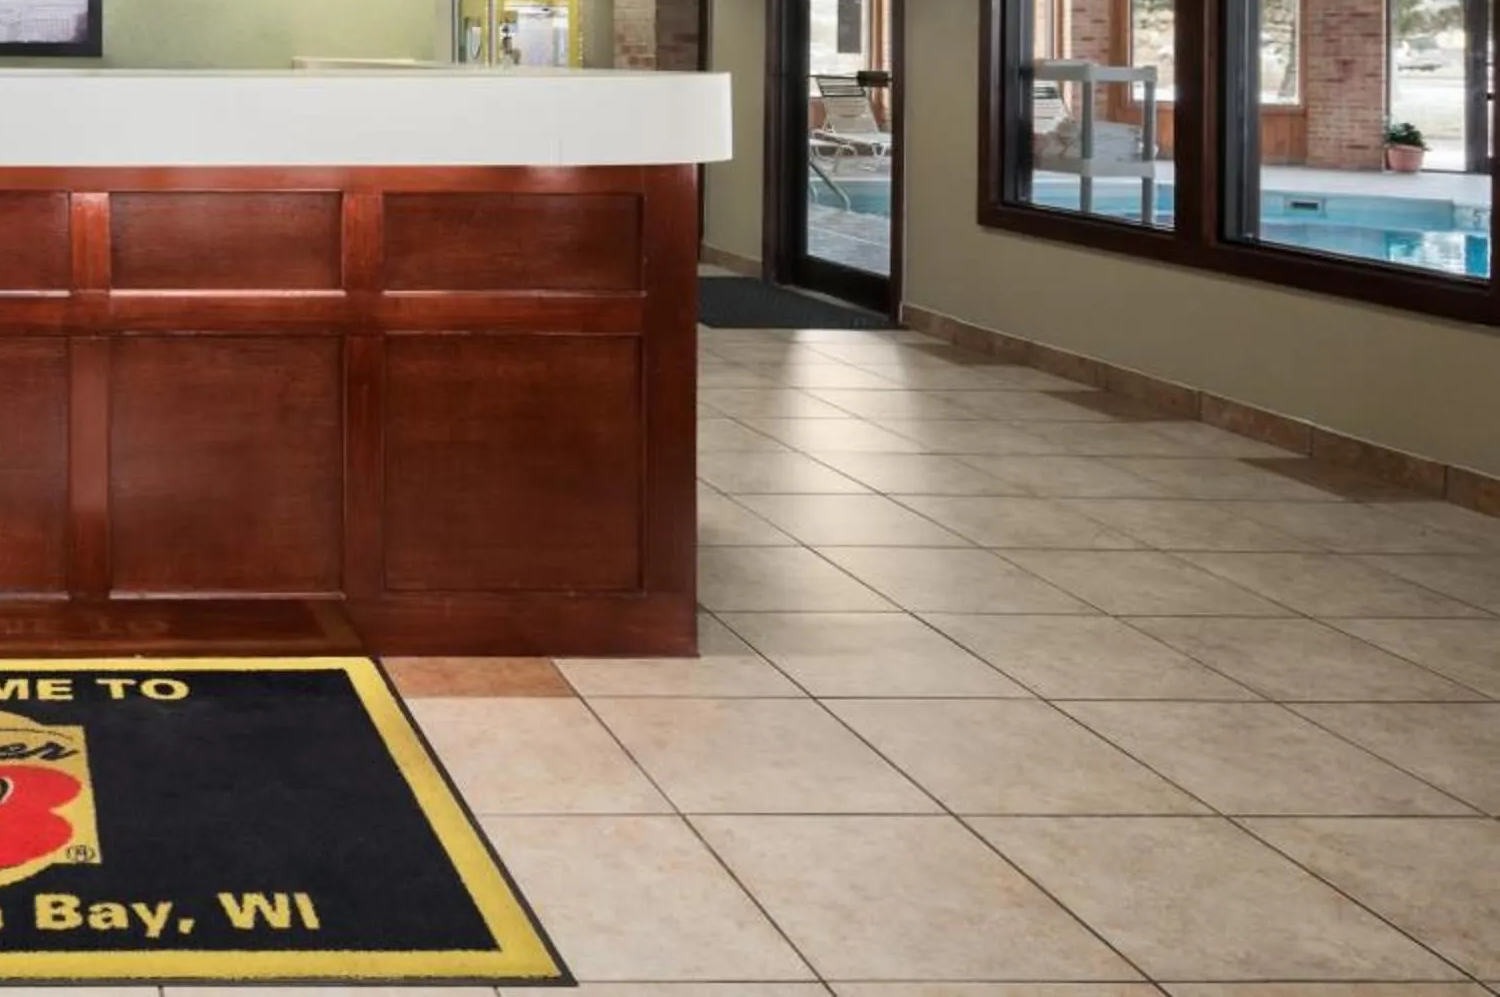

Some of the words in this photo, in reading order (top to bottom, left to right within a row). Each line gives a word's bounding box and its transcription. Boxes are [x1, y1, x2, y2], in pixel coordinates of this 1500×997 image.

[96, 678, 190, 700] TO
[33, 893, 195, 938] Bay,
[218, 892, 320, 930] WI
